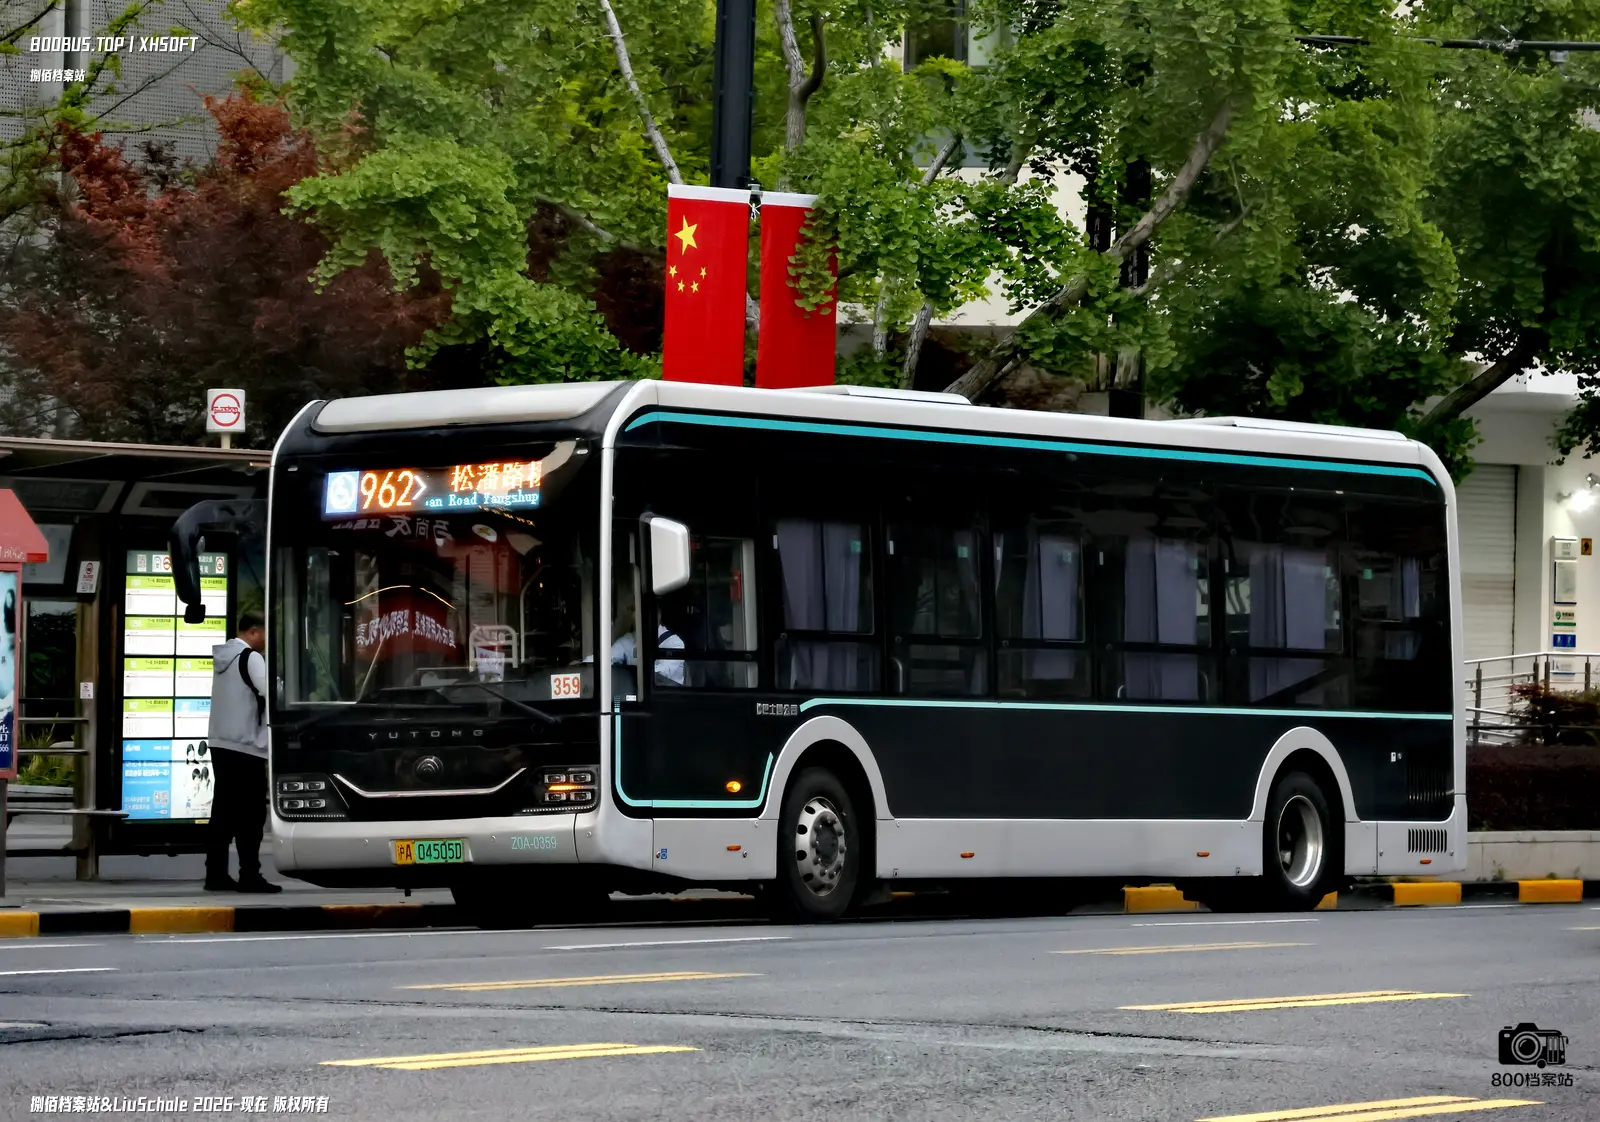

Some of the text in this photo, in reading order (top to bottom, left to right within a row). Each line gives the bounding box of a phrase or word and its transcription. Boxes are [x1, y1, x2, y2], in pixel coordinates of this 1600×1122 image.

[361, 471, 414, 509] 962
[425, 497, 443, 507] an
[448, 492, 477, 507] Road
[553, 676, 581, 696] 359
[368, 729, 483, 740] YUTONG
[418, 843, 462, 860] 04505D
